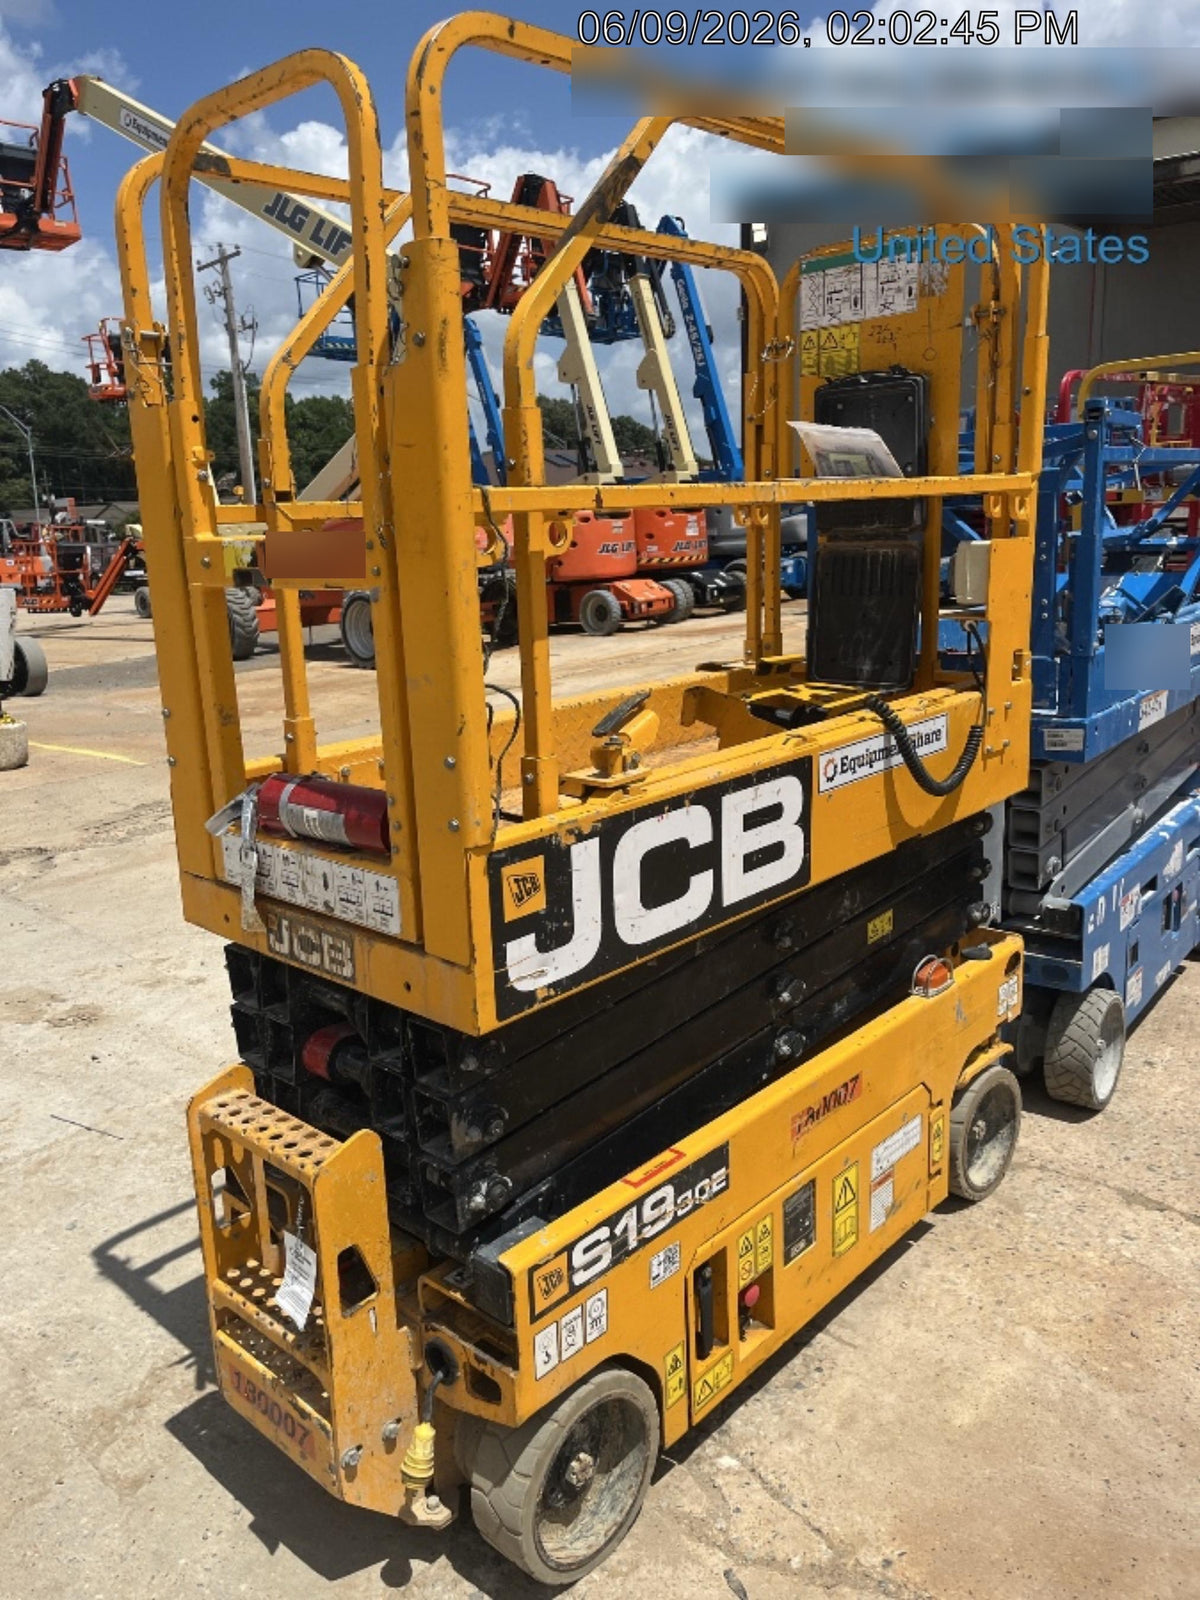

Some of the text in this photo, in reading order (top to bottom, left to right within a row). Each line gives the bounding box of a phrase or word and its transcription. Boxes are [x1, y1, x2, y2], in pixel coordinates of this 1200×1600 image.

[262, 192, 310, 234] JLG
[598, 542, 619, 554] JLG
[671, 540, 691, 552] JLG
[839, 728, 942, 776] Equipmehare
[505, 774, 805, 992] JCB
[513, 875, 540, 903] JCB
[268, 918, 355, 978] JCB
